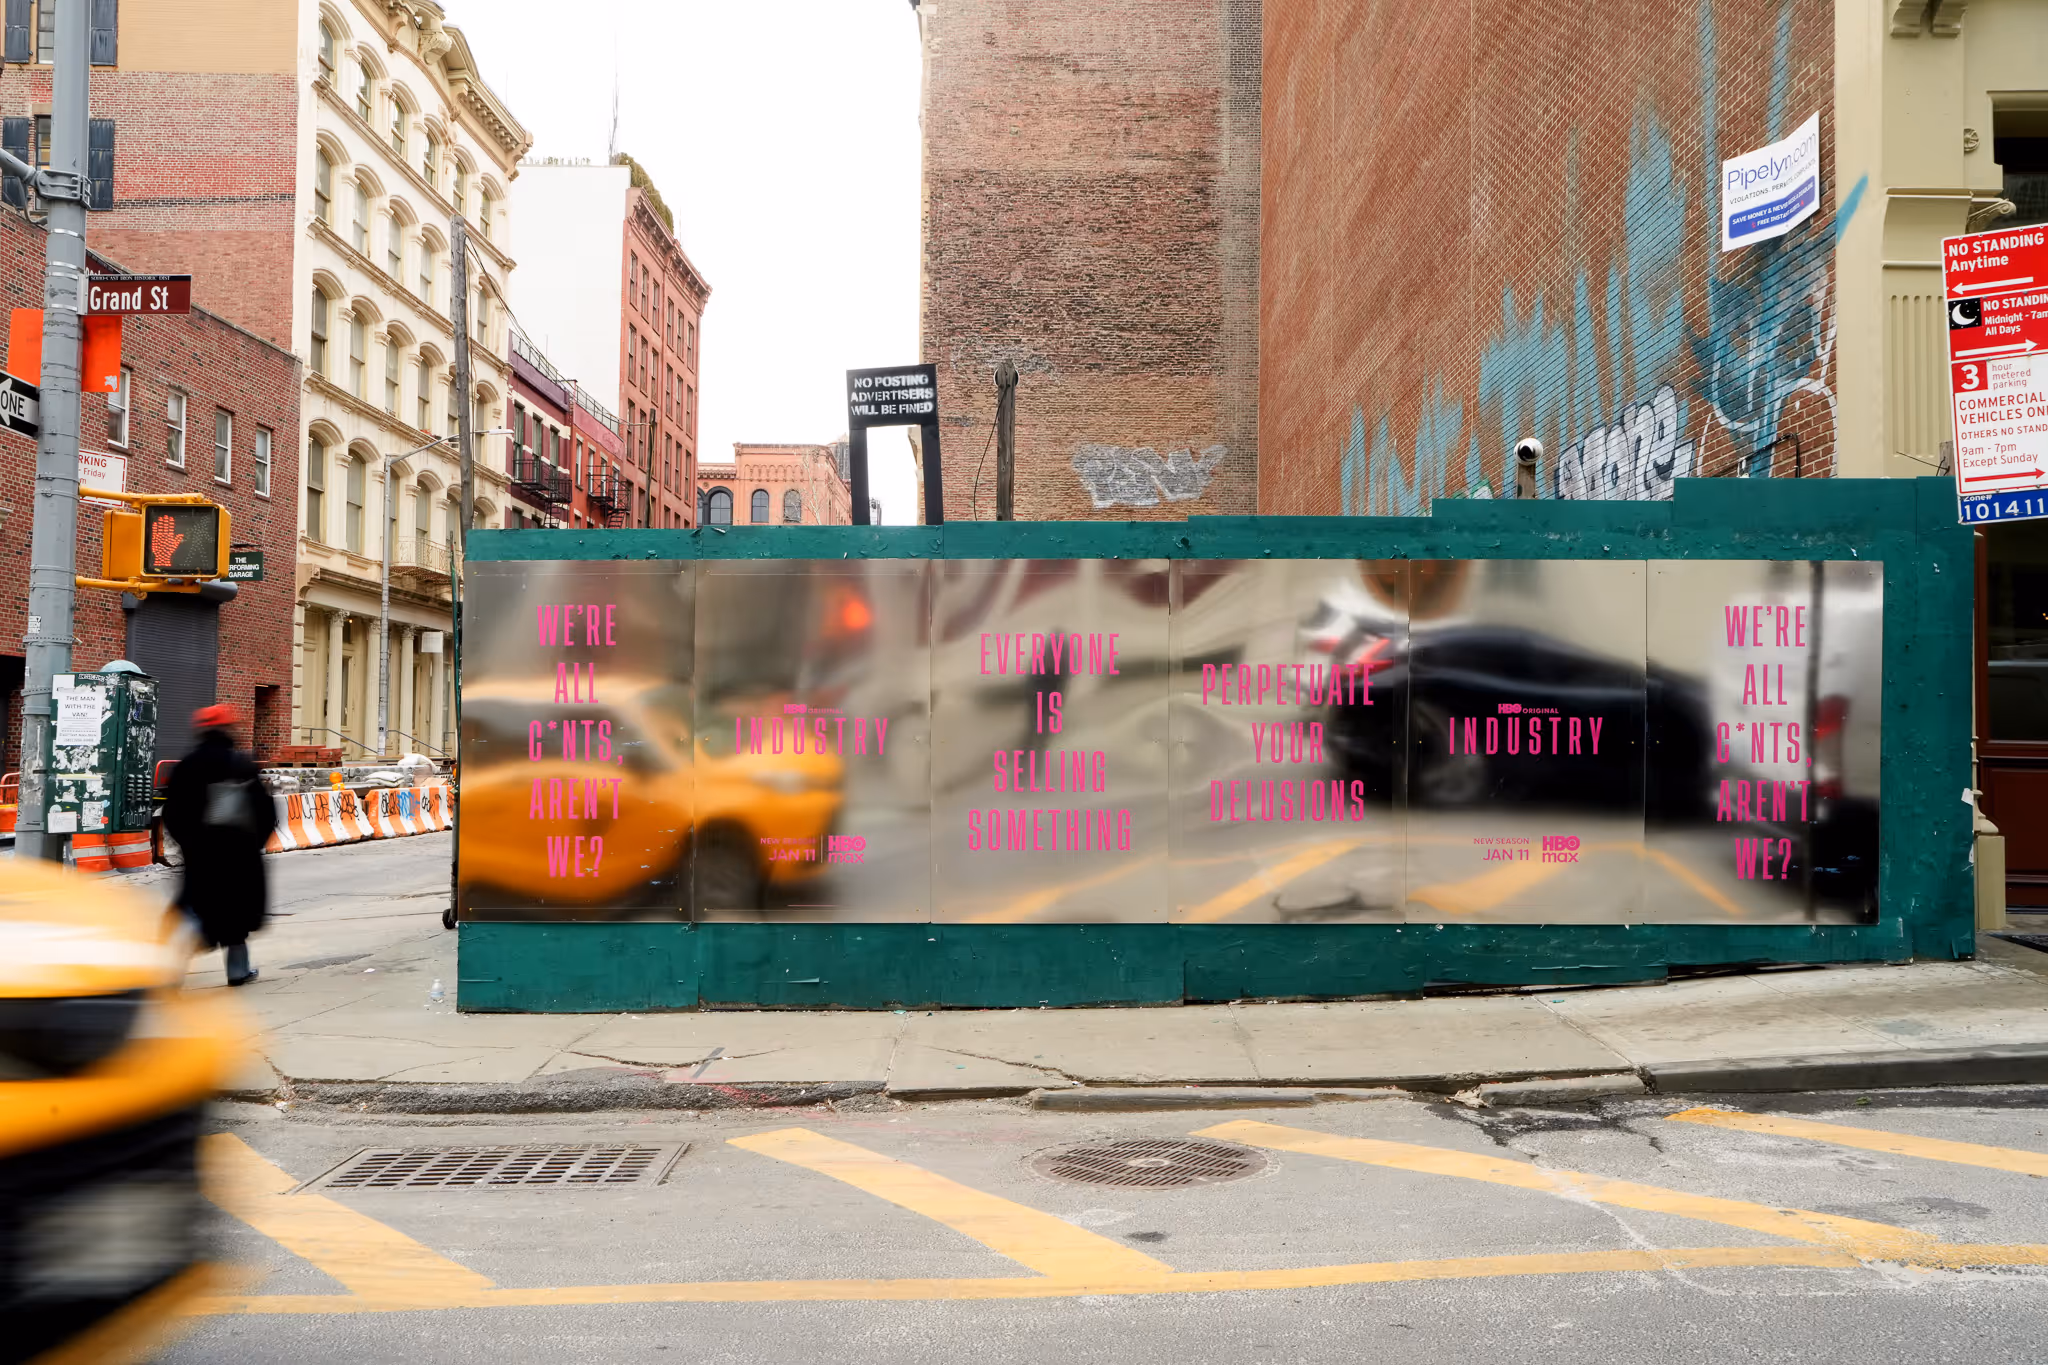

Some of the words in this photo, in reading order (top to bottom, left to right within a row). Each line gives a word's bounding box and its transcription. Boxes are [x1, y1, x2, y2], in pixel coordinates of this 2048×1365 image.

[1728, 132, 1816, 190] Pipelyn.com
[1732, 215, 1746, 225] SAVE
[1747, 209, 1767, 220] MONEY
[1757, 218, 1770, 226] FREE
[1948, 243, 1968, 257] NO
[1973, 232, 2044, 254] STANDING
[1950, 255, 2009, 272] Anytime
[90, 286, 141, 310] Grand
[150, 286, 168, 310] St
[1983, 300, 1999, 311] NO
[1984, 312, 2023, 325] Midnight
[1985, 327, 1997, 336] All
[2000, 325, 2021, 336] Days
[1992, 363, 2012, 372] hour
[1992, 369, 2031, 380] metered
[854, 378, 872, 388] NO
[875, 374, 929, 387] POSTING
[1960, 364, 1980, 390] 3
[1993, 379, 2027, 390] parking
[0, 390, 24, 417] ONE
[851, 388, 934, 402] ADVERTISERS
[1959, 392, 2046, 411] COMMERCIAL
[851, 404, 878, 415] WILL
[881, 404, 896, 414] BE
[899, 401, 933, 414] FINED
[1960, 408, 2023, 424] VEHICLES
[1961, 429, 1998, 440] OTHERS
[2001, 427, 2013, 436] NO
[1962, 446, 1984, 456] 9am
[1996, 443, 2016, 455] 7pm
[79, 454, 107, 468] RKING
[1963, 455, 1997, 468] Except
[2000, 453, 2038, 465] Sunday
[84, 468, 106, 479] Friday
[1964, 498, 2044, 520] 101411
[537, 605, 616, 647] WE'RE
[1725, 605, 1806, 647] WE'RE
[980, 632, 1120, 675] EVERYONE
[554, 663, 599, 704] ALL
[1202, 663, 1374, 706] PERPETUATE
[1743, 664, 1788, 706] ALL
[784, 704, 807, 714] HBO
[1036, 692, 1063, 734] IS
[1498, 703, 1522, 714] HBO
[736, 717, 888, 755] INDUSTRY
[1251, 722, 1324, 764] YOUR
[1449, 717, 1603, 755] INDUSTRY
[993, 750, 1106, 793] SELLING
[529, 778, 623, 820] AREN'T
[1210, 779, 1365, 822] DELUSIONS
[1716, 780, 1811, 822] AREN'T
[968, 808, 1131, 851] SOMETHING
[828, 835, 866, 852] HBO
[1542, 835, 1580, 851] HBO
[548, 836, 603, 877] WE?
[769, 849, 799, 861] JAN
[804, 849, 815, 861] 11
[828, 853, 864, 863] max
[1483, 849, 1513, 861] JAN
[1517, 849, 1529, 860] 11
[1542, 852, 1579, 863] max
[1735, 838, 1792, 880] WE?
